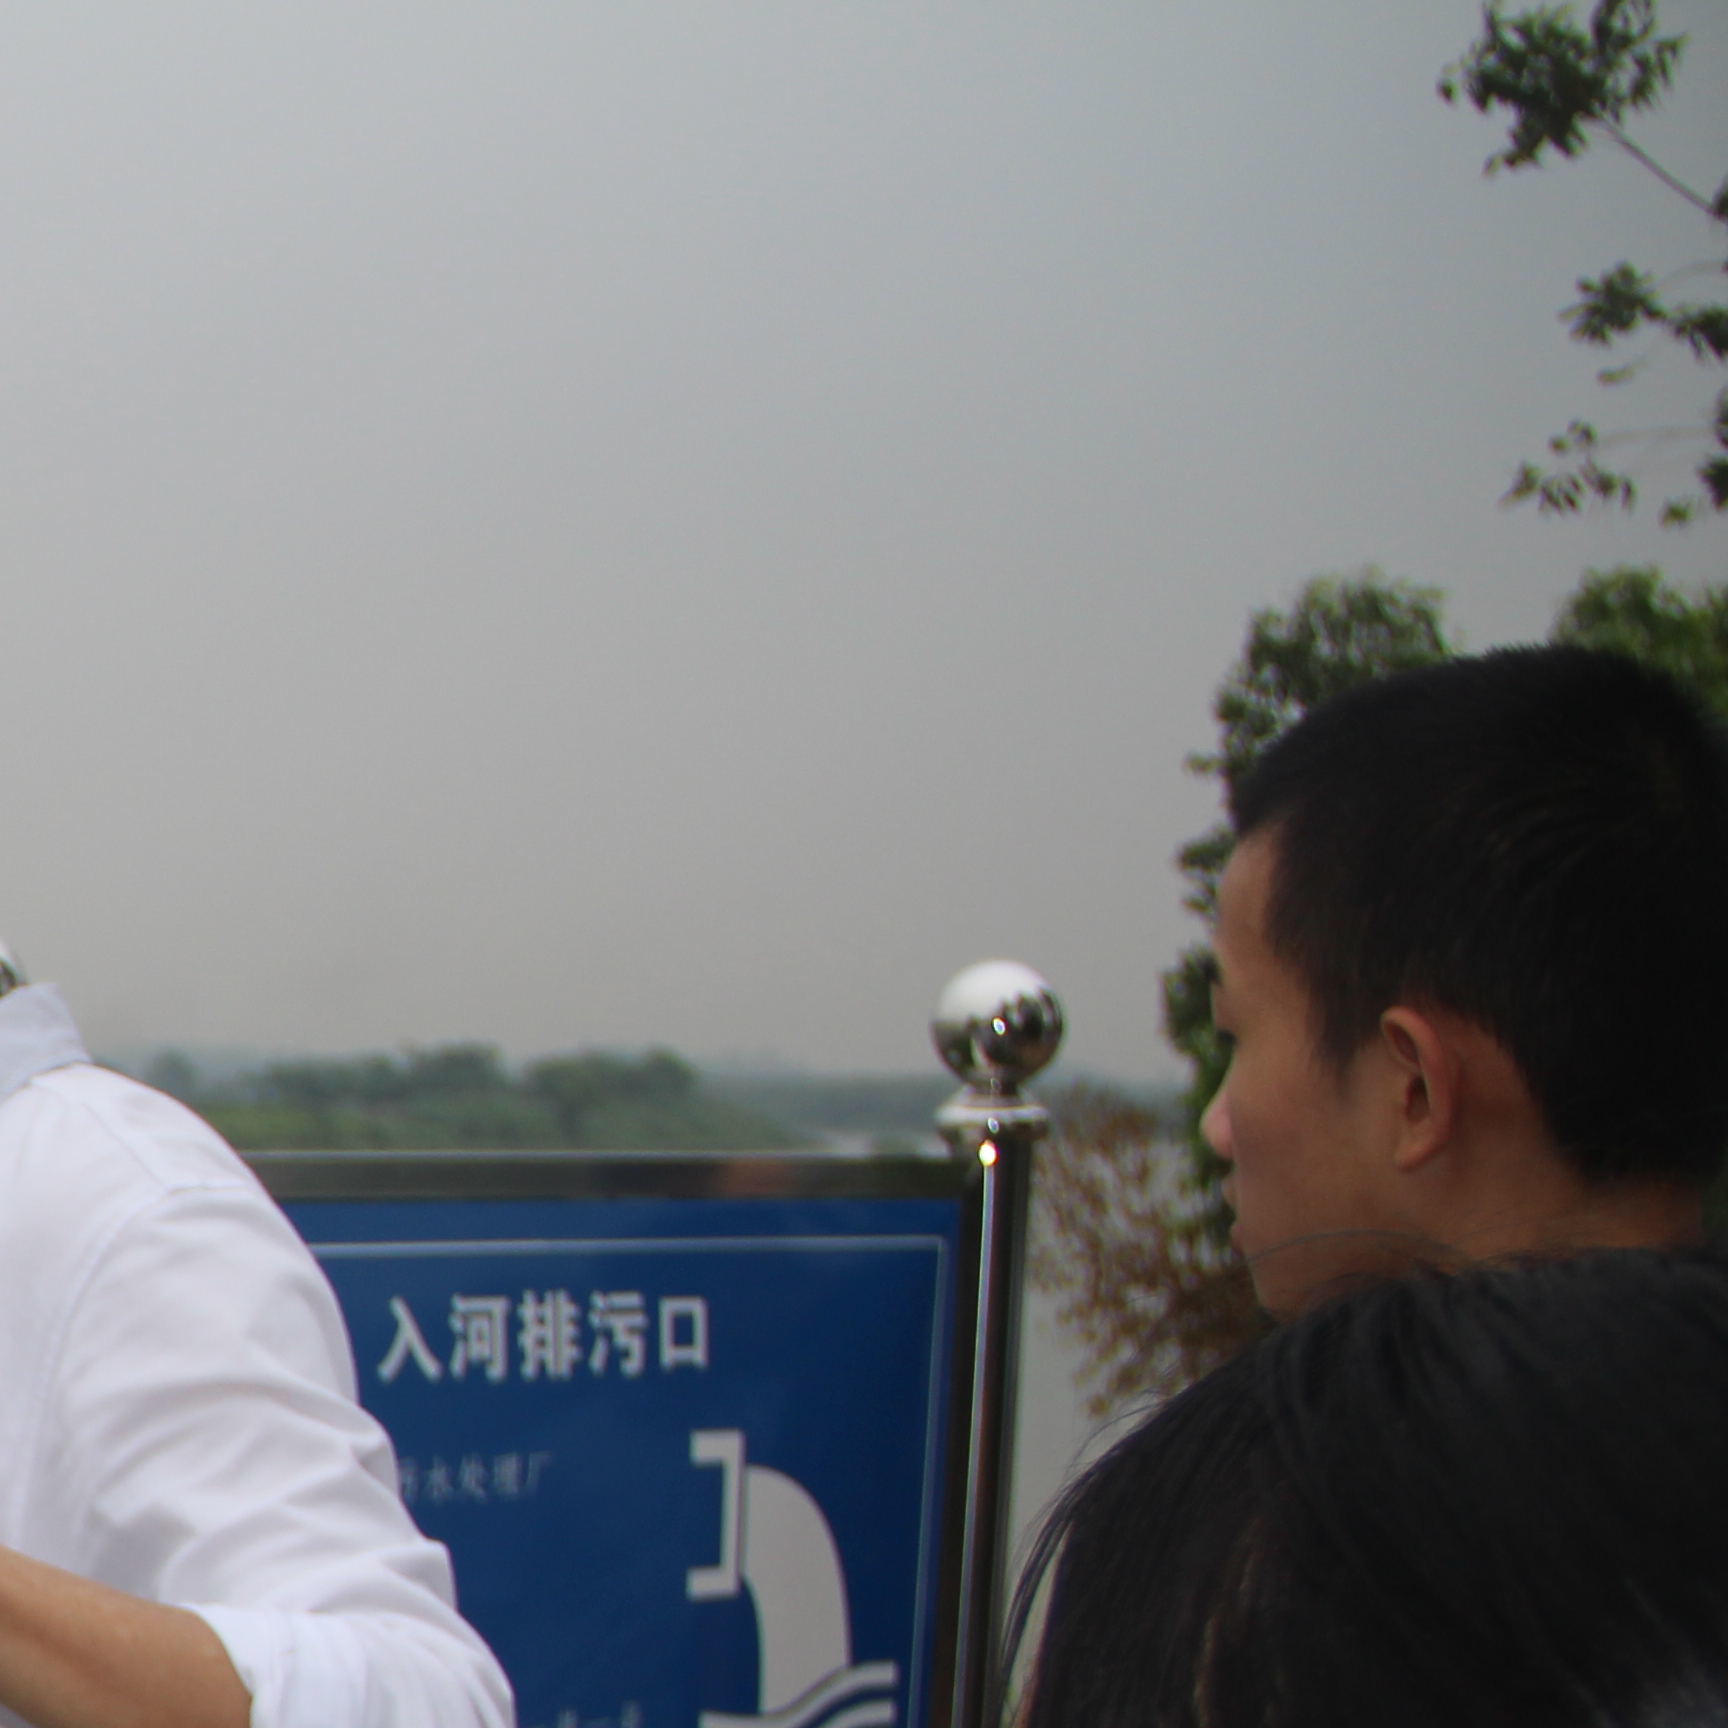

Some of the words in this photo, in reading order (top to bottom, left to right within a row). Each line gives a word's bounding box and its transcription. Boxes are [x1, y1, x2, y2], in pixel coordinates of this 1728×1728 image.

[376, 1287, 710, 1384] 入河排污口
